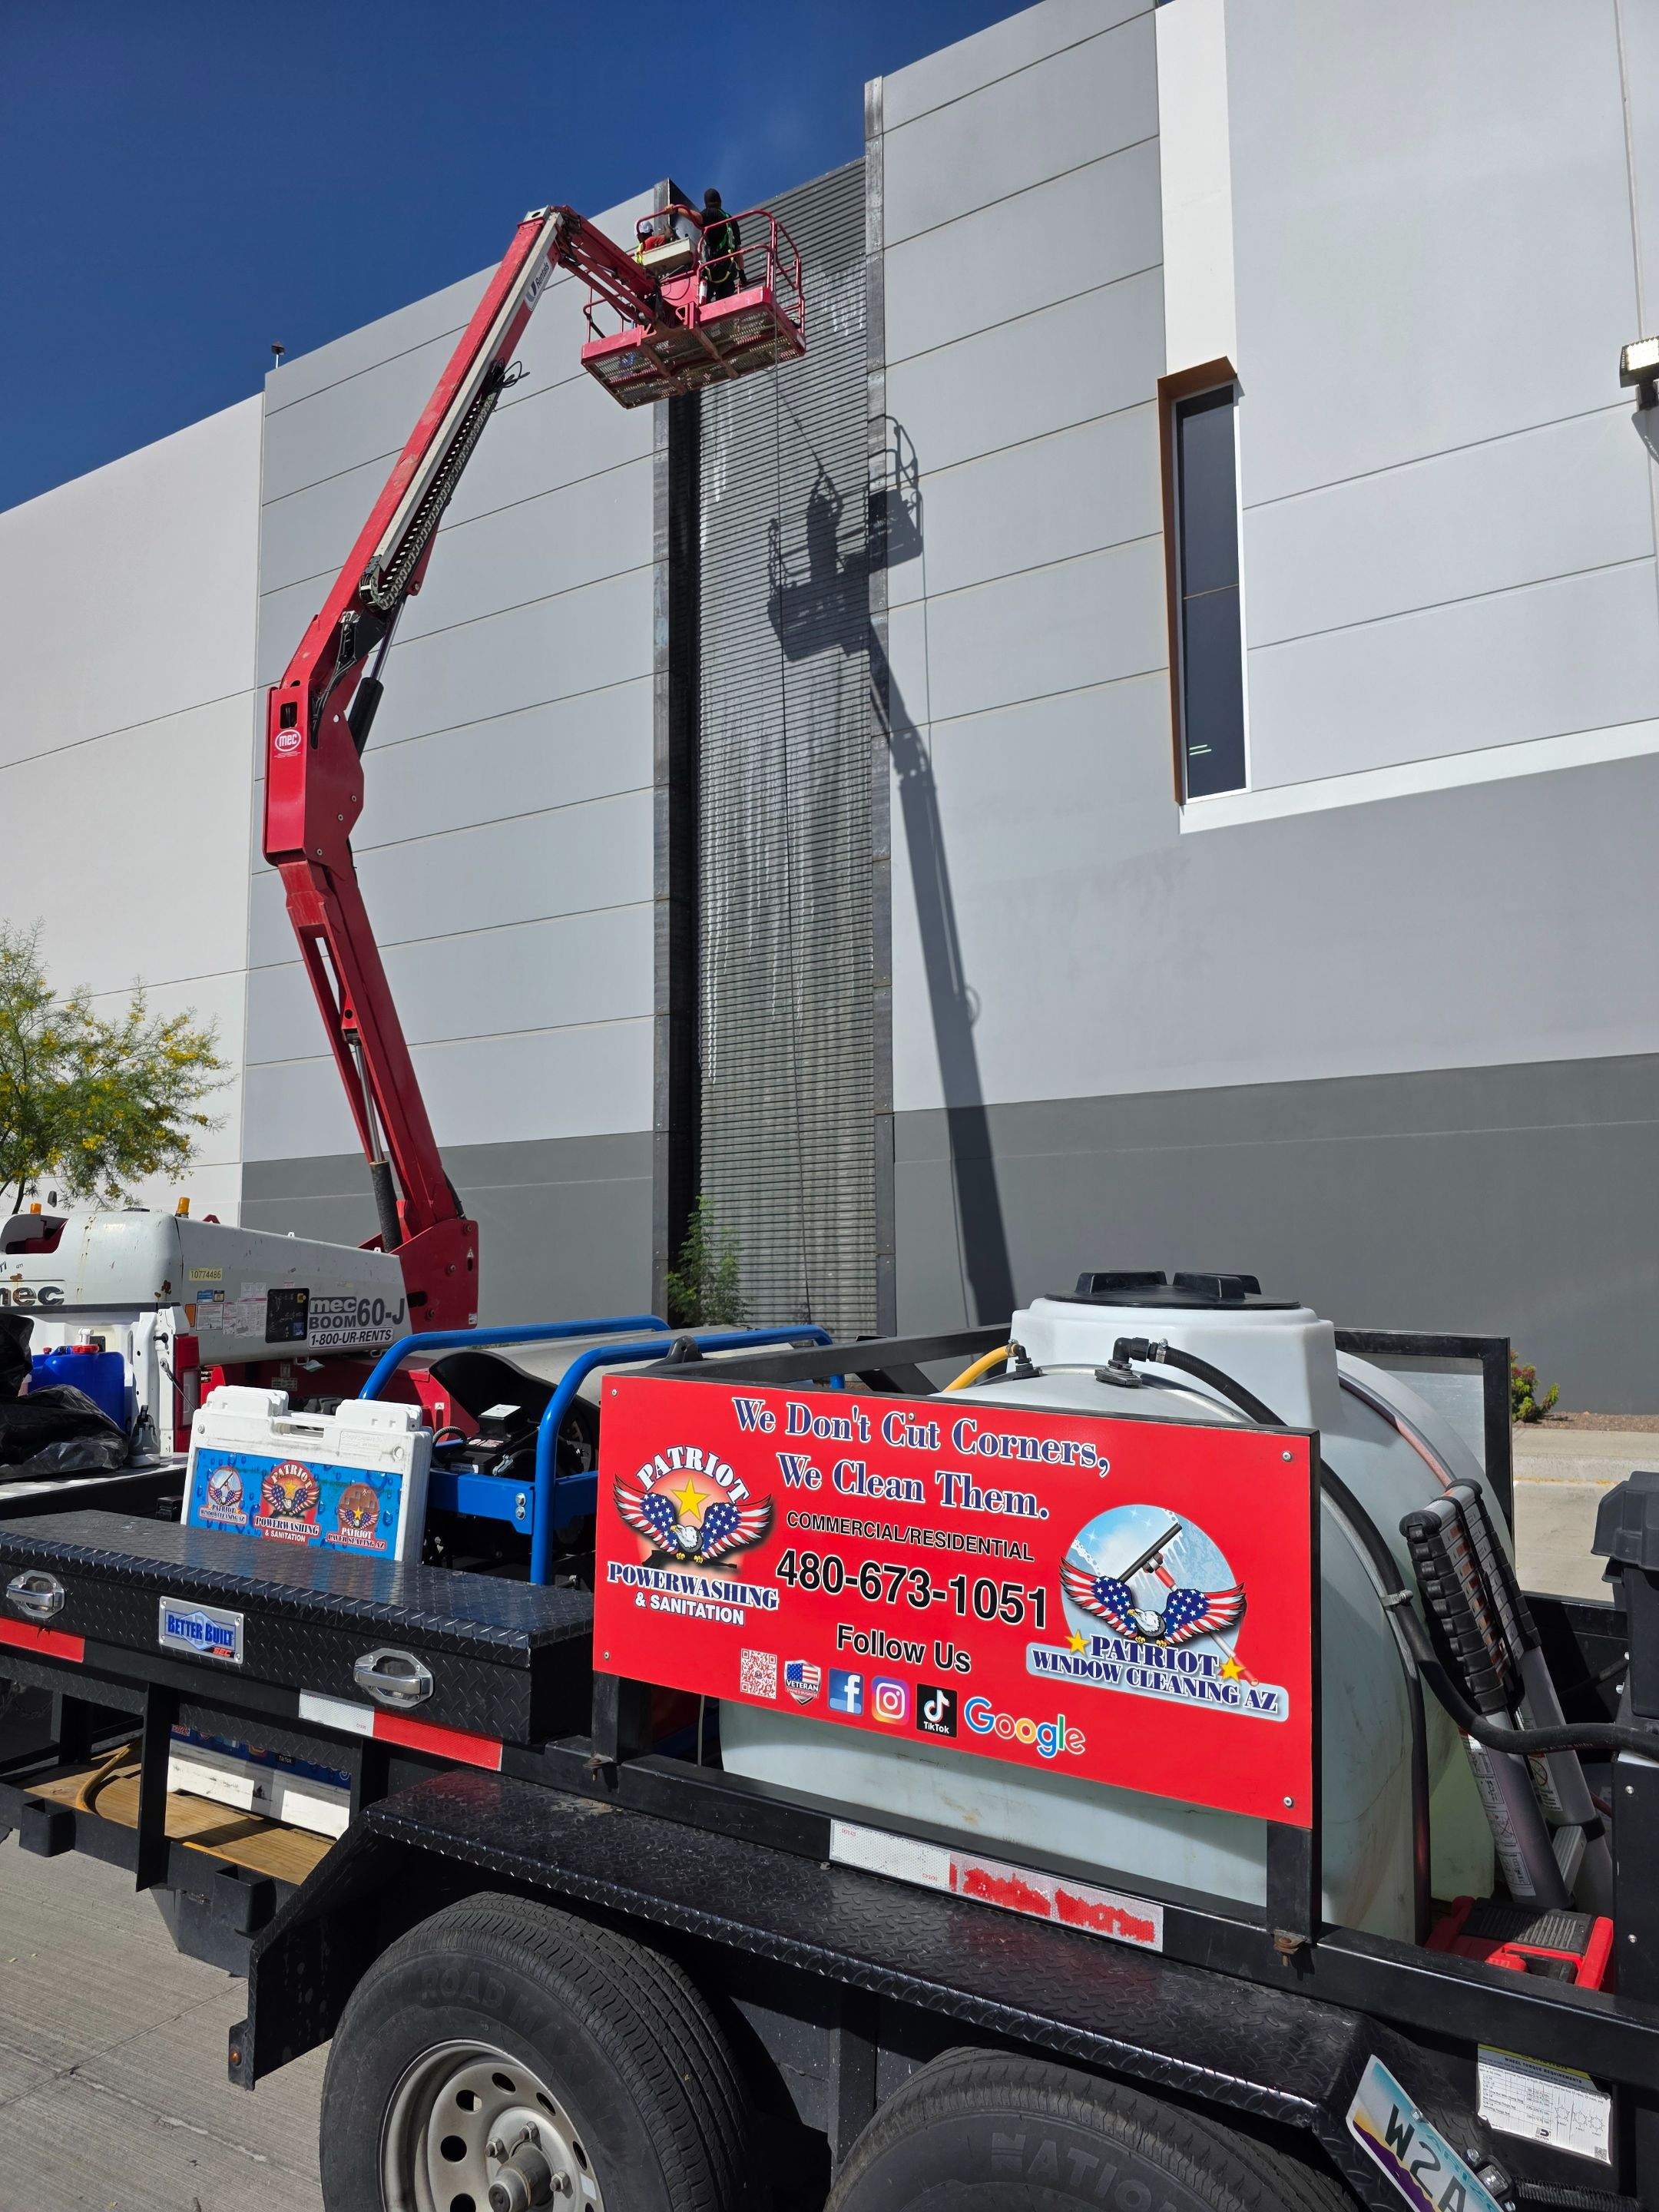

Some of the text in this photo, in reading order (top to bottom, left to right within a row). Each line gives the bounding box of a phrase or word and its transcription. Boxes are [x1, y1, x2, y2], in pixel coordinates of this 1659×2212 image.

[279, 733, 297, 747] mec
[191, 1270, 221, 1280] 10774486
[310, 1299, 356, 1313] mec
[357, 1298, 405, 1326] 60-J
[309, 1316, 356, 1329] BOOM
[311, 1330, 391, 1346] 1-800-UR-RENTS
[731, 1396, 1111, 1477] We Don't Cut Corners,
[271, 1464, 313, 1488] PATRIOT
[636, 1445, 750, 1504] PATRIOT
[777, 1452, 1050, 1520] We Clean Them.
[255, 1516, 320, 1535] POWERWASHING
[271, 1530, 306, 1542] SANITATION
[341, 1528, 373, 1539] PATRIOT
[786, 1511, 1035, 1562] COMMERCIAL/RESIDENTIAL
[376, 1541, 385, 1549] AZ
[608, 1561, 779, 1610] POWERWASHING
[776, 1548, 1047, 1629] 480-673-1051
[635, 1591, 744, 1626] & SANITATION
[167, 1614, 233, 1647] BETTER BUILT
[836, 1624, 972, 1674] Follow Us
[1091, 1634, 1220, 1680] PATRIOT
[786, 1679, 819, 1692] VETERAN
[1031, 1648, 1278, 1714] WINDOW CLEANING AZ
[924, 1720, 949, 1734] TikTok
[963, 1697, 1086, 1758] Google
[991, 2131, 1179, 2212] NATIO
